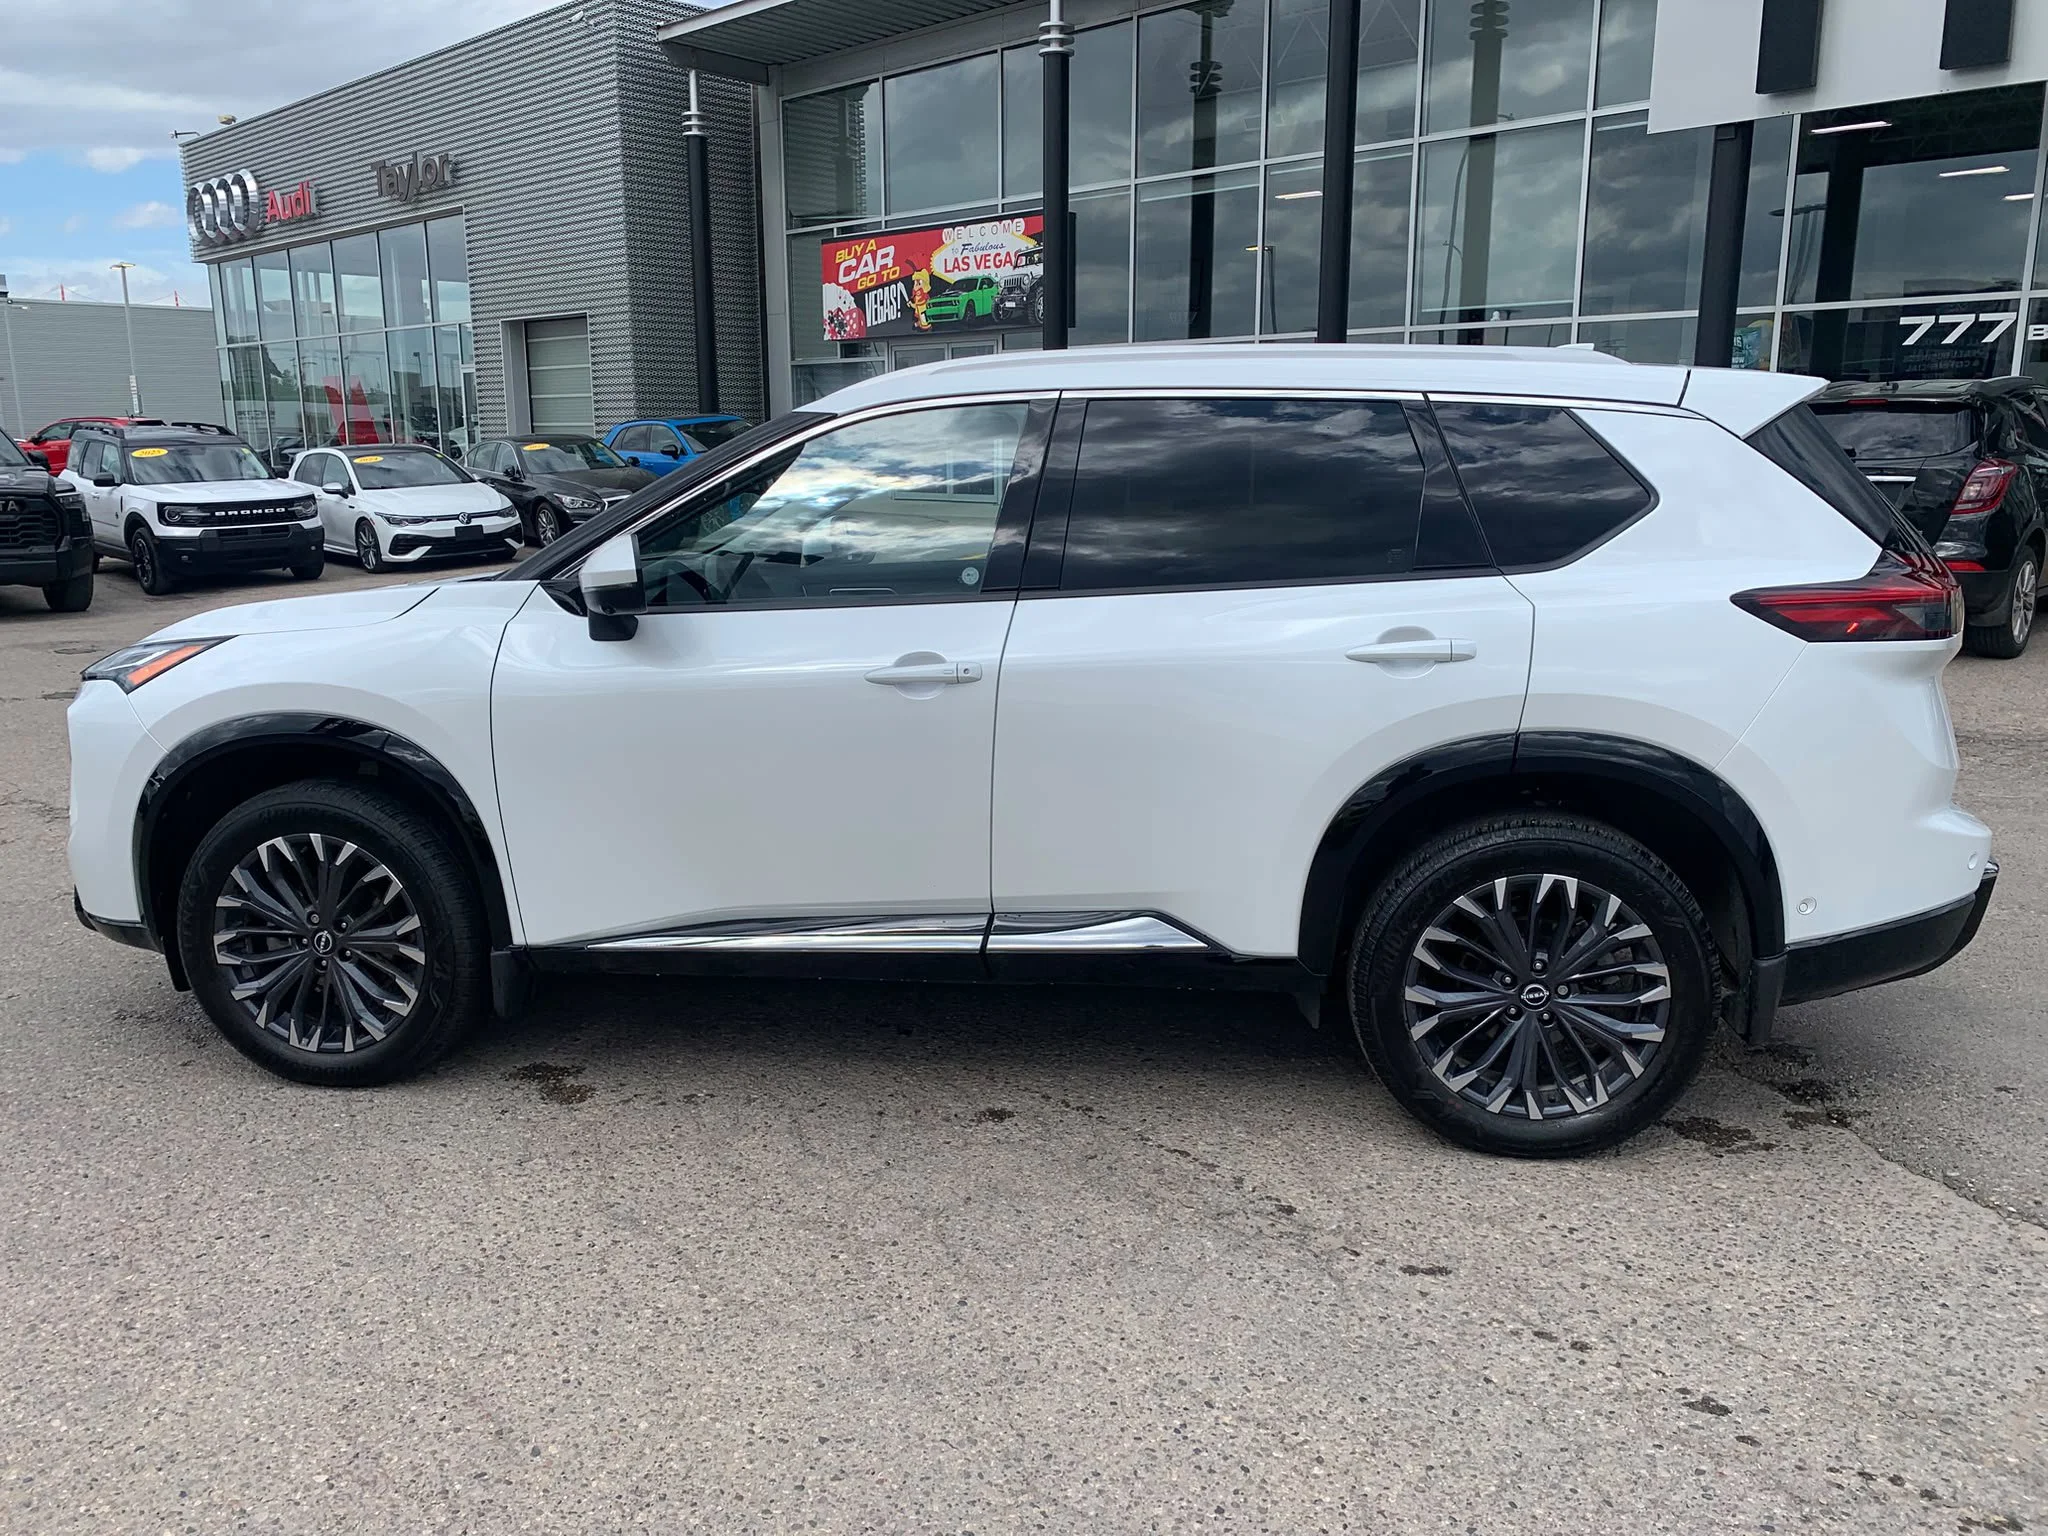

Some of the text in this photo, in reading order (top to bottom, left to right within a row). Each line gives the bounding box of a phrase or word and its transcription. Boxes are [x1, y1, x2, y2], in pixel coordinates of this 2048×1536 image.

[370, 150, 453, 201] Taylor
[265, 179, 315, 223] Audi
[943, 221, 1022, 241] WELCOME
[835, 239, 877, 263] BUY A
[952, 242, 1006, 255] to Fabulous
[838, 245, 895, 284] CAR
[944, 255, 970, 273] LAS
[857, 266, 900, 290] GO TO
[864, 281, 902, 328] VEGAS!
[1899, 311, 2018, 346] 777
[214, 507, 286, 517] BRONCO
[1521, 990, 1549, 999] NISSAN
